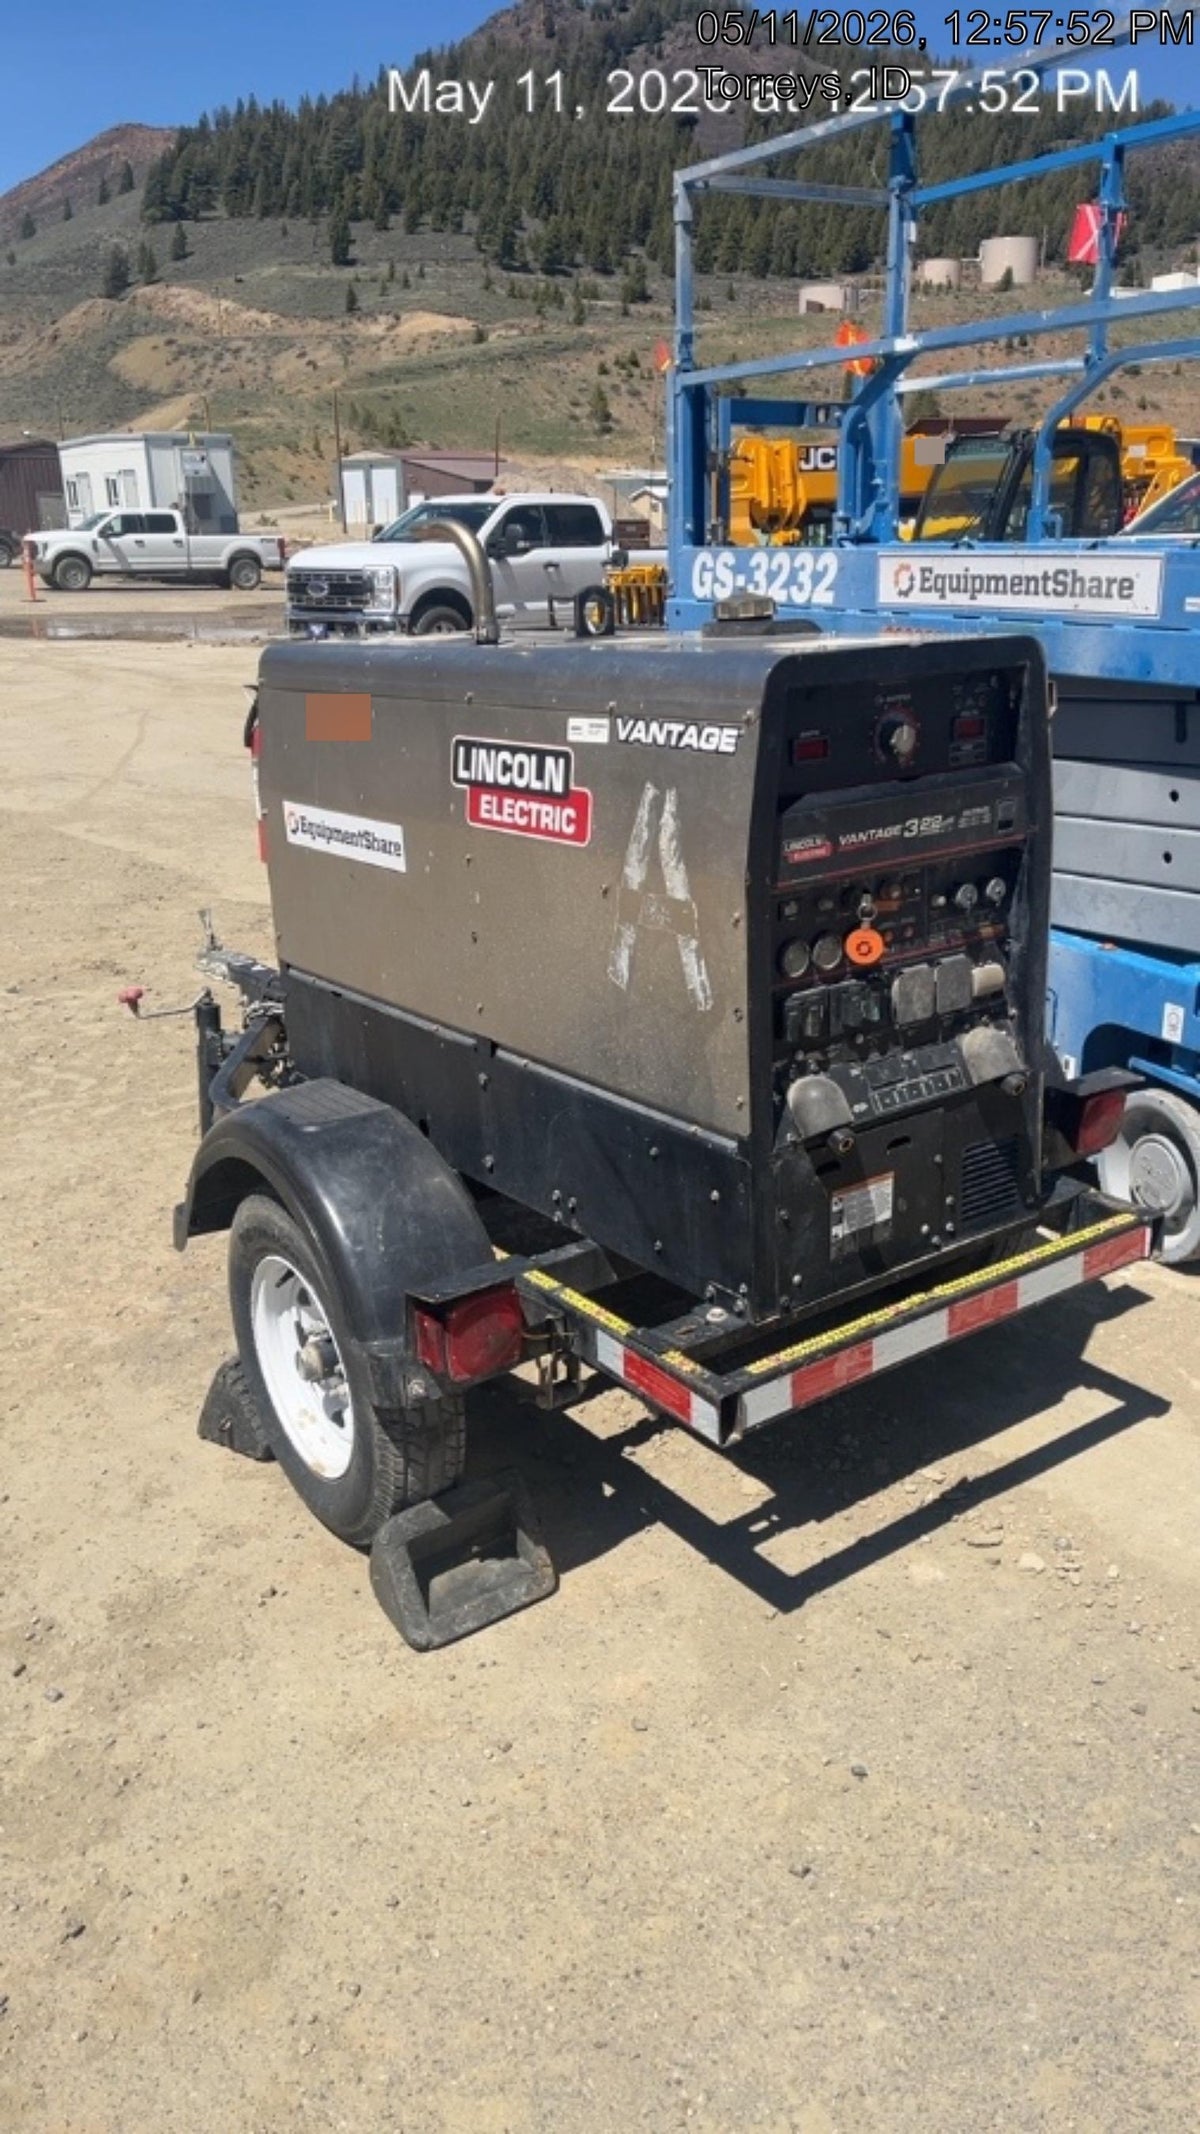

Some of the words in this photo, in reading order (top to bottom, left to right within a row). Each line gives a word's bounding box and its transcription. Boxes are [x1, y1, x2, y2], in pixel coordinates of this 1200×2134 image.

[799, 447, 836, 471] JC
[691, 551, 838, 604] GS-3232
[919, 566, 1135, 600] EquipmentShare
[615, 717, 741, 753] VANTAGE
[456, 746, 566, 794] LINCOLN
[479, 794, 577, 835] ELECTRIC
[299, 814, 402, 857] EquipmentShare
